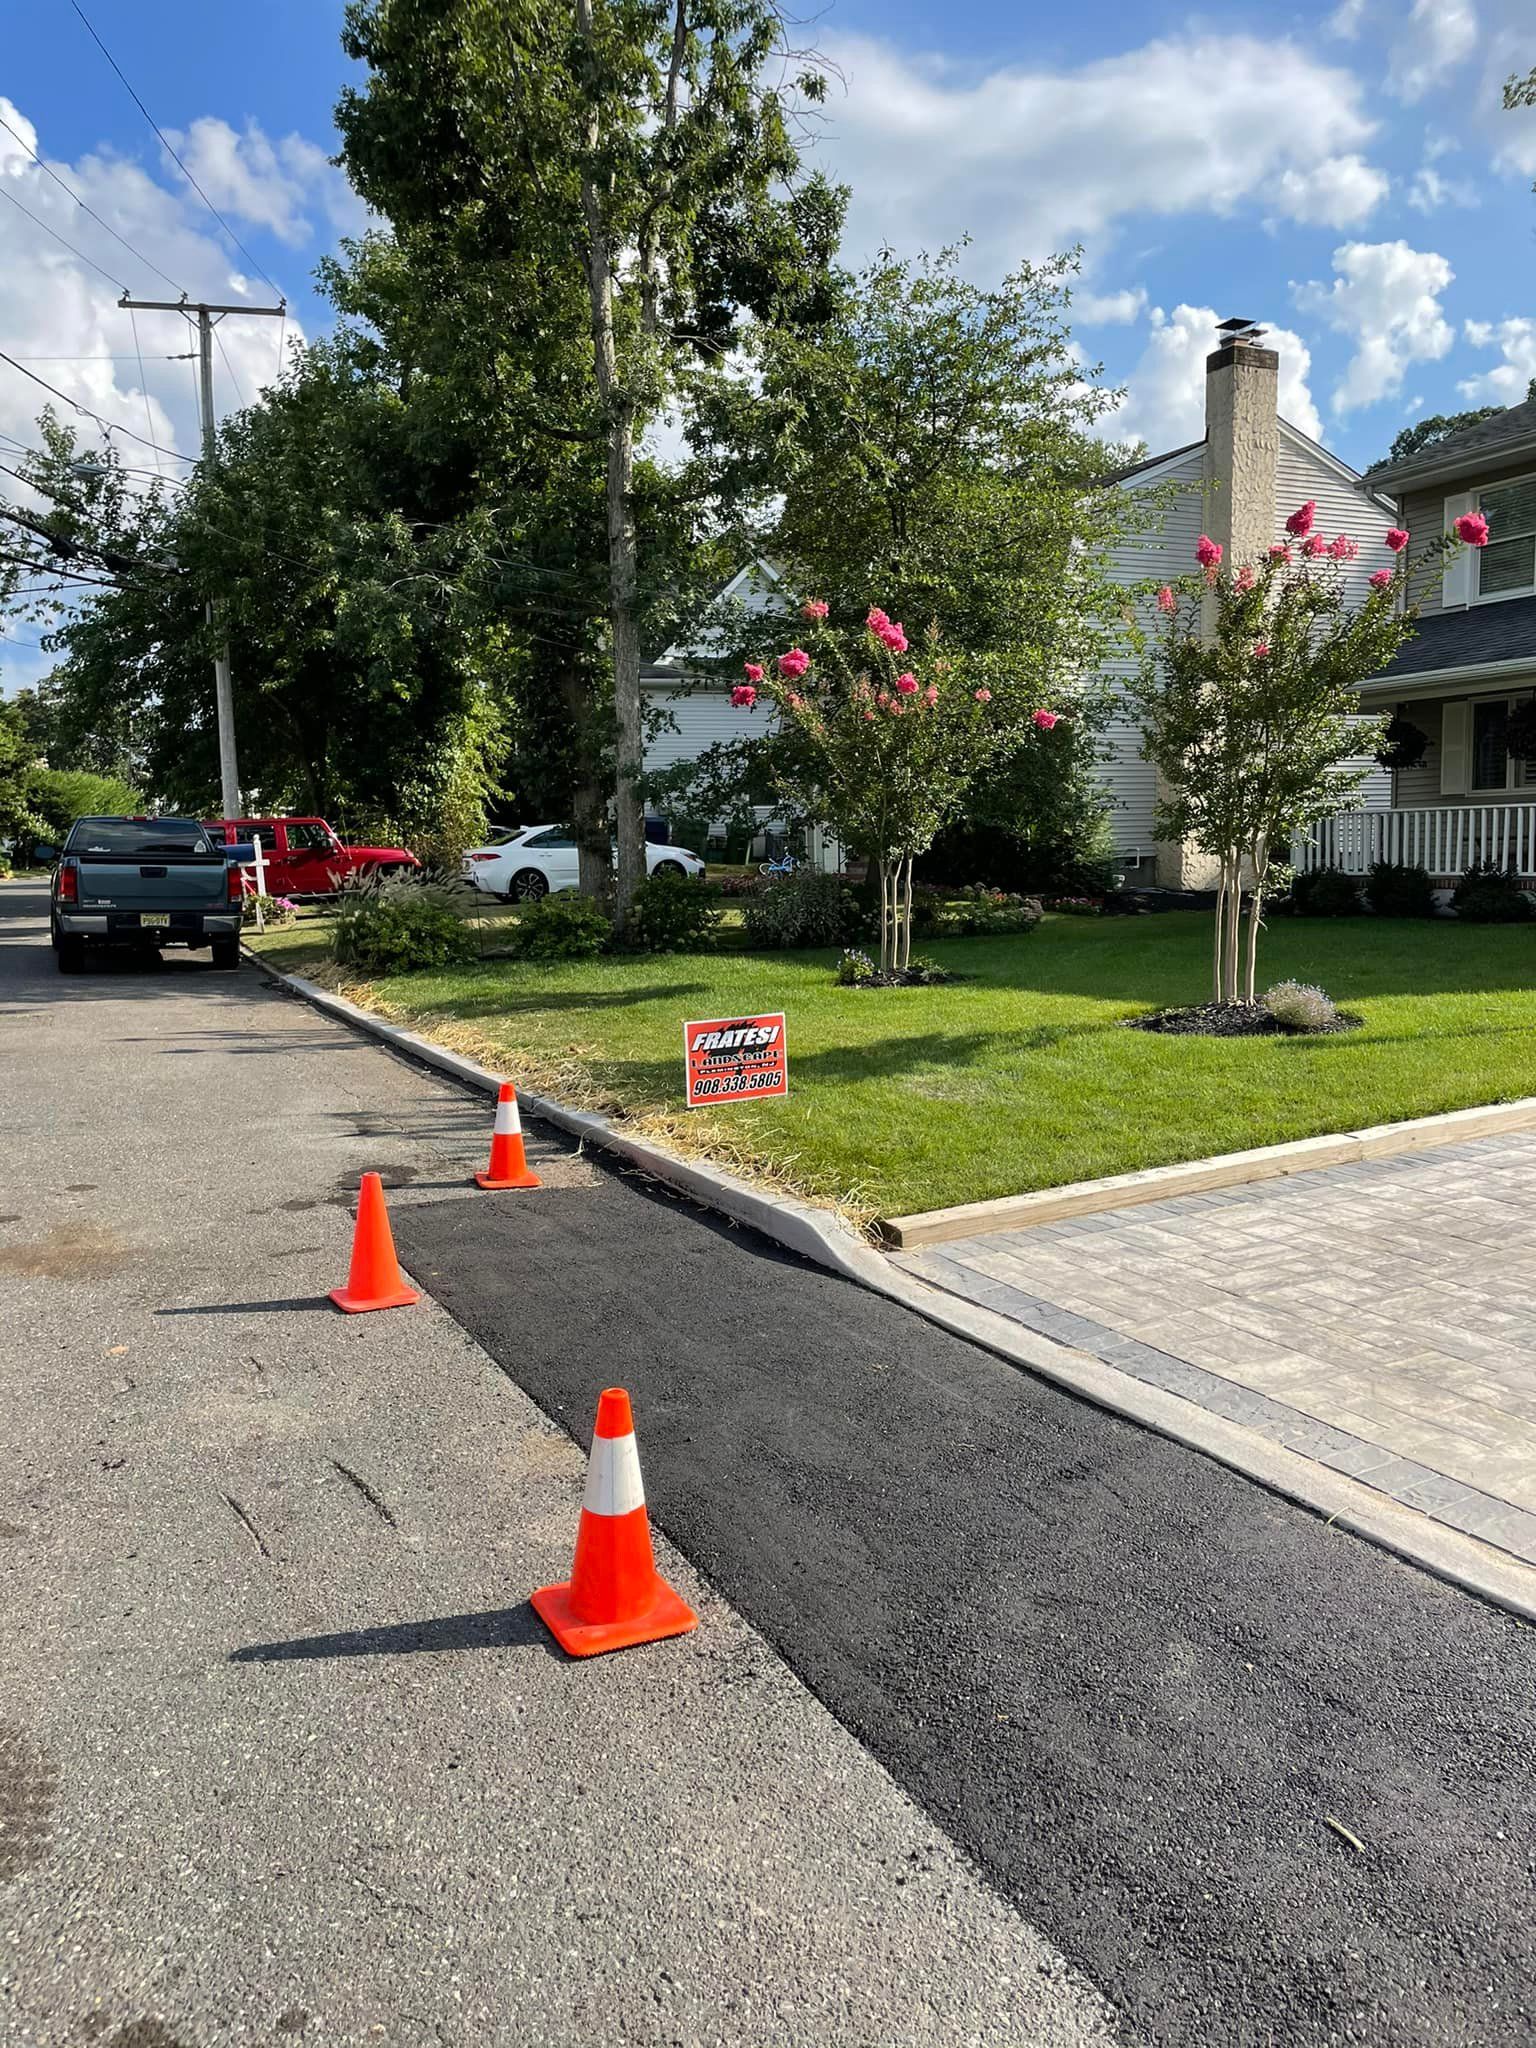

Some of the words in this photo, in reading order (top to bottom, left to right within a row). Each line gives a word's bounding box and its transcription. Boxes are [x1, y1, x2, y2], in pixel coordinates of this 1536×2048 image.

[691, 1025, 780, 1052] FRATESI
[692, 1050, 783, 1068] LANDSCAPE
[693, 1071, 782, 1097] 908.338.5805
